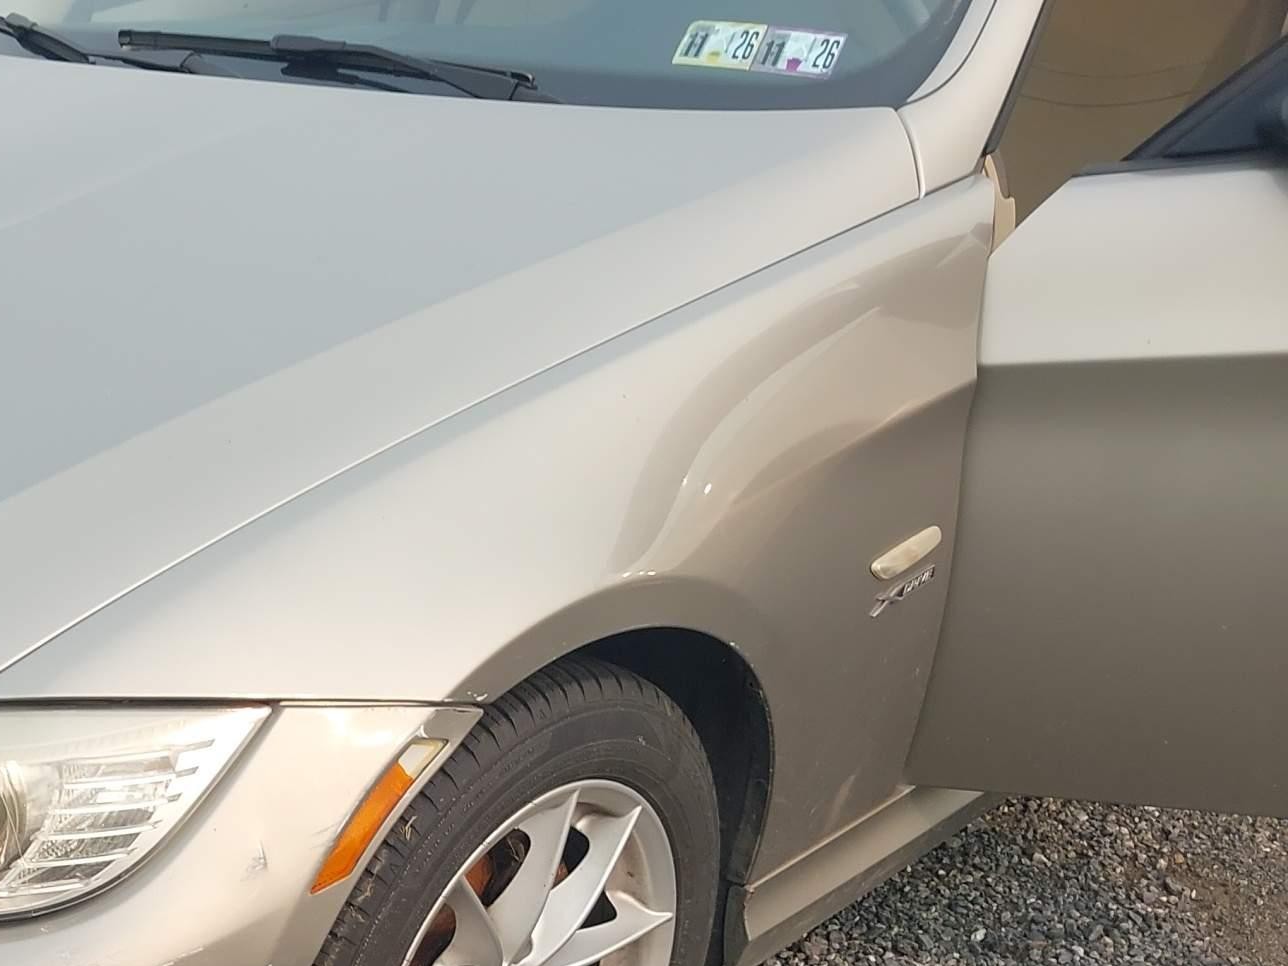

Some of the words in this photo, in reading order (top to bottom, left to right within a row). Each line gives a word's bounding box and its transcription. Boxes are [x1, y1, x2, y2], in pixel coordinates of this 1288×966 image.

[683, 32, 709, 57] 11
[731, 30, 759, 60] 26
[761, 40, 787, 67] 11
[812, 39, 841, 69] 26
